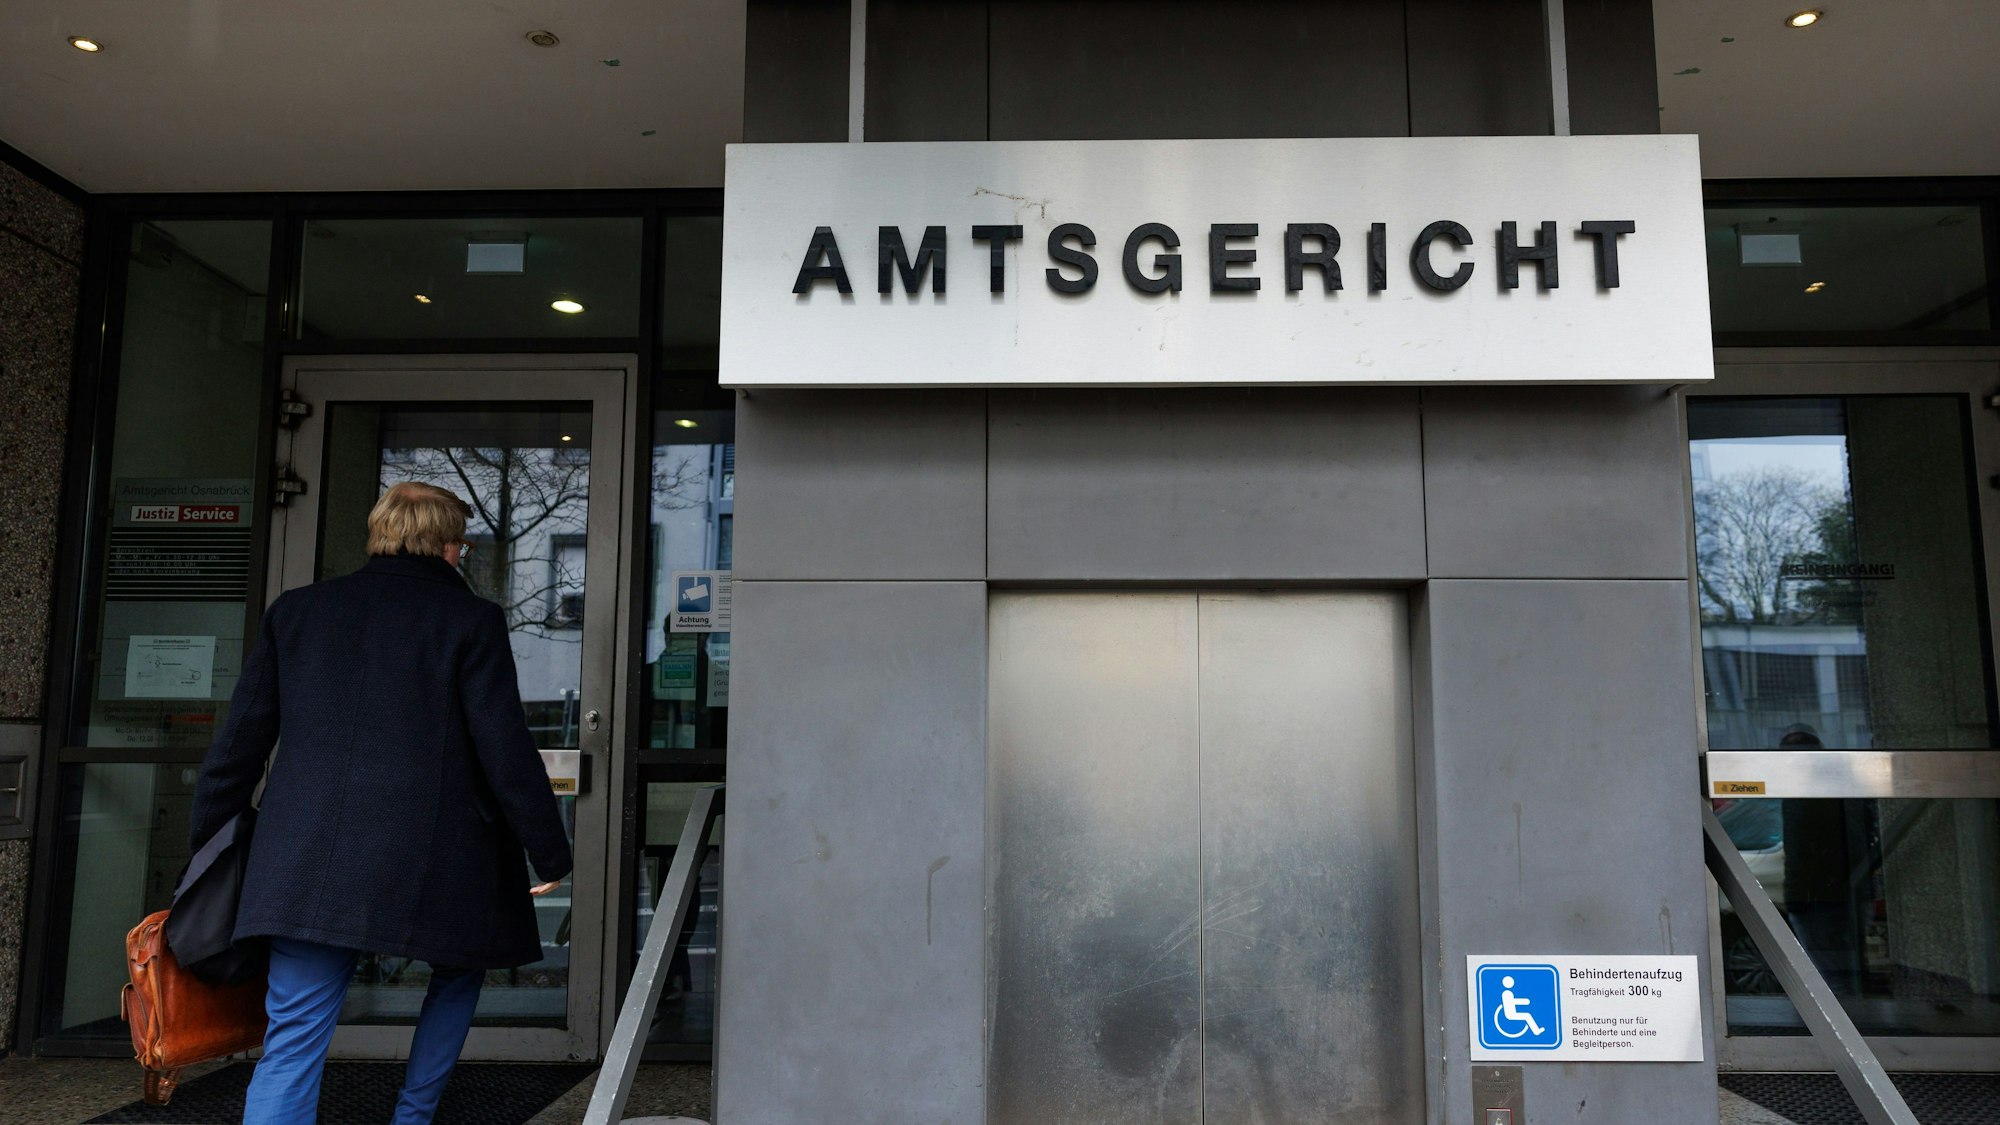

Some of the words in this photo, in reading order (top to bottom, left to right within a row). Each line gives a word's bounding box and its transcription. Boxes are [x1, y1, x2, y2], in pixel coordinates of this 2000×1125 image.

[793, 219, 1635, 295] AMTSGERICHT
[122, 485, 187, 497] Amtsgericht
[191, 484, 249, 496] Osnabrück
[136, 507, 175, 520] Justiz
[183, 507, 234, 520] Service
[1824, 564, 1894, 575] EINGANG!
[678, 616, 709, 625] Achtung
[1730, 784, 1759, 792] Ziehen
[1570, 968, 1682, 982] Behindertenaufzug
[1570, 987, 1625, 998] Tragfähigkeit
[1628, 985, 1648, 996] 300
[1651, 988, 1662, 998] kg
[1572, 1016, 1617, 1026] Benutzung
[1619, 1017, 1634, 1025] nur
[1635, 1016, 1648, 1025] für
[1572, 1028, 1618, 1036] Behinderte
[1620, 1028, 1637, 1036] und
[1639, 1029, 1657, 1037] eine
[1573, 1039, 1634, 1049] Begleitperson.
